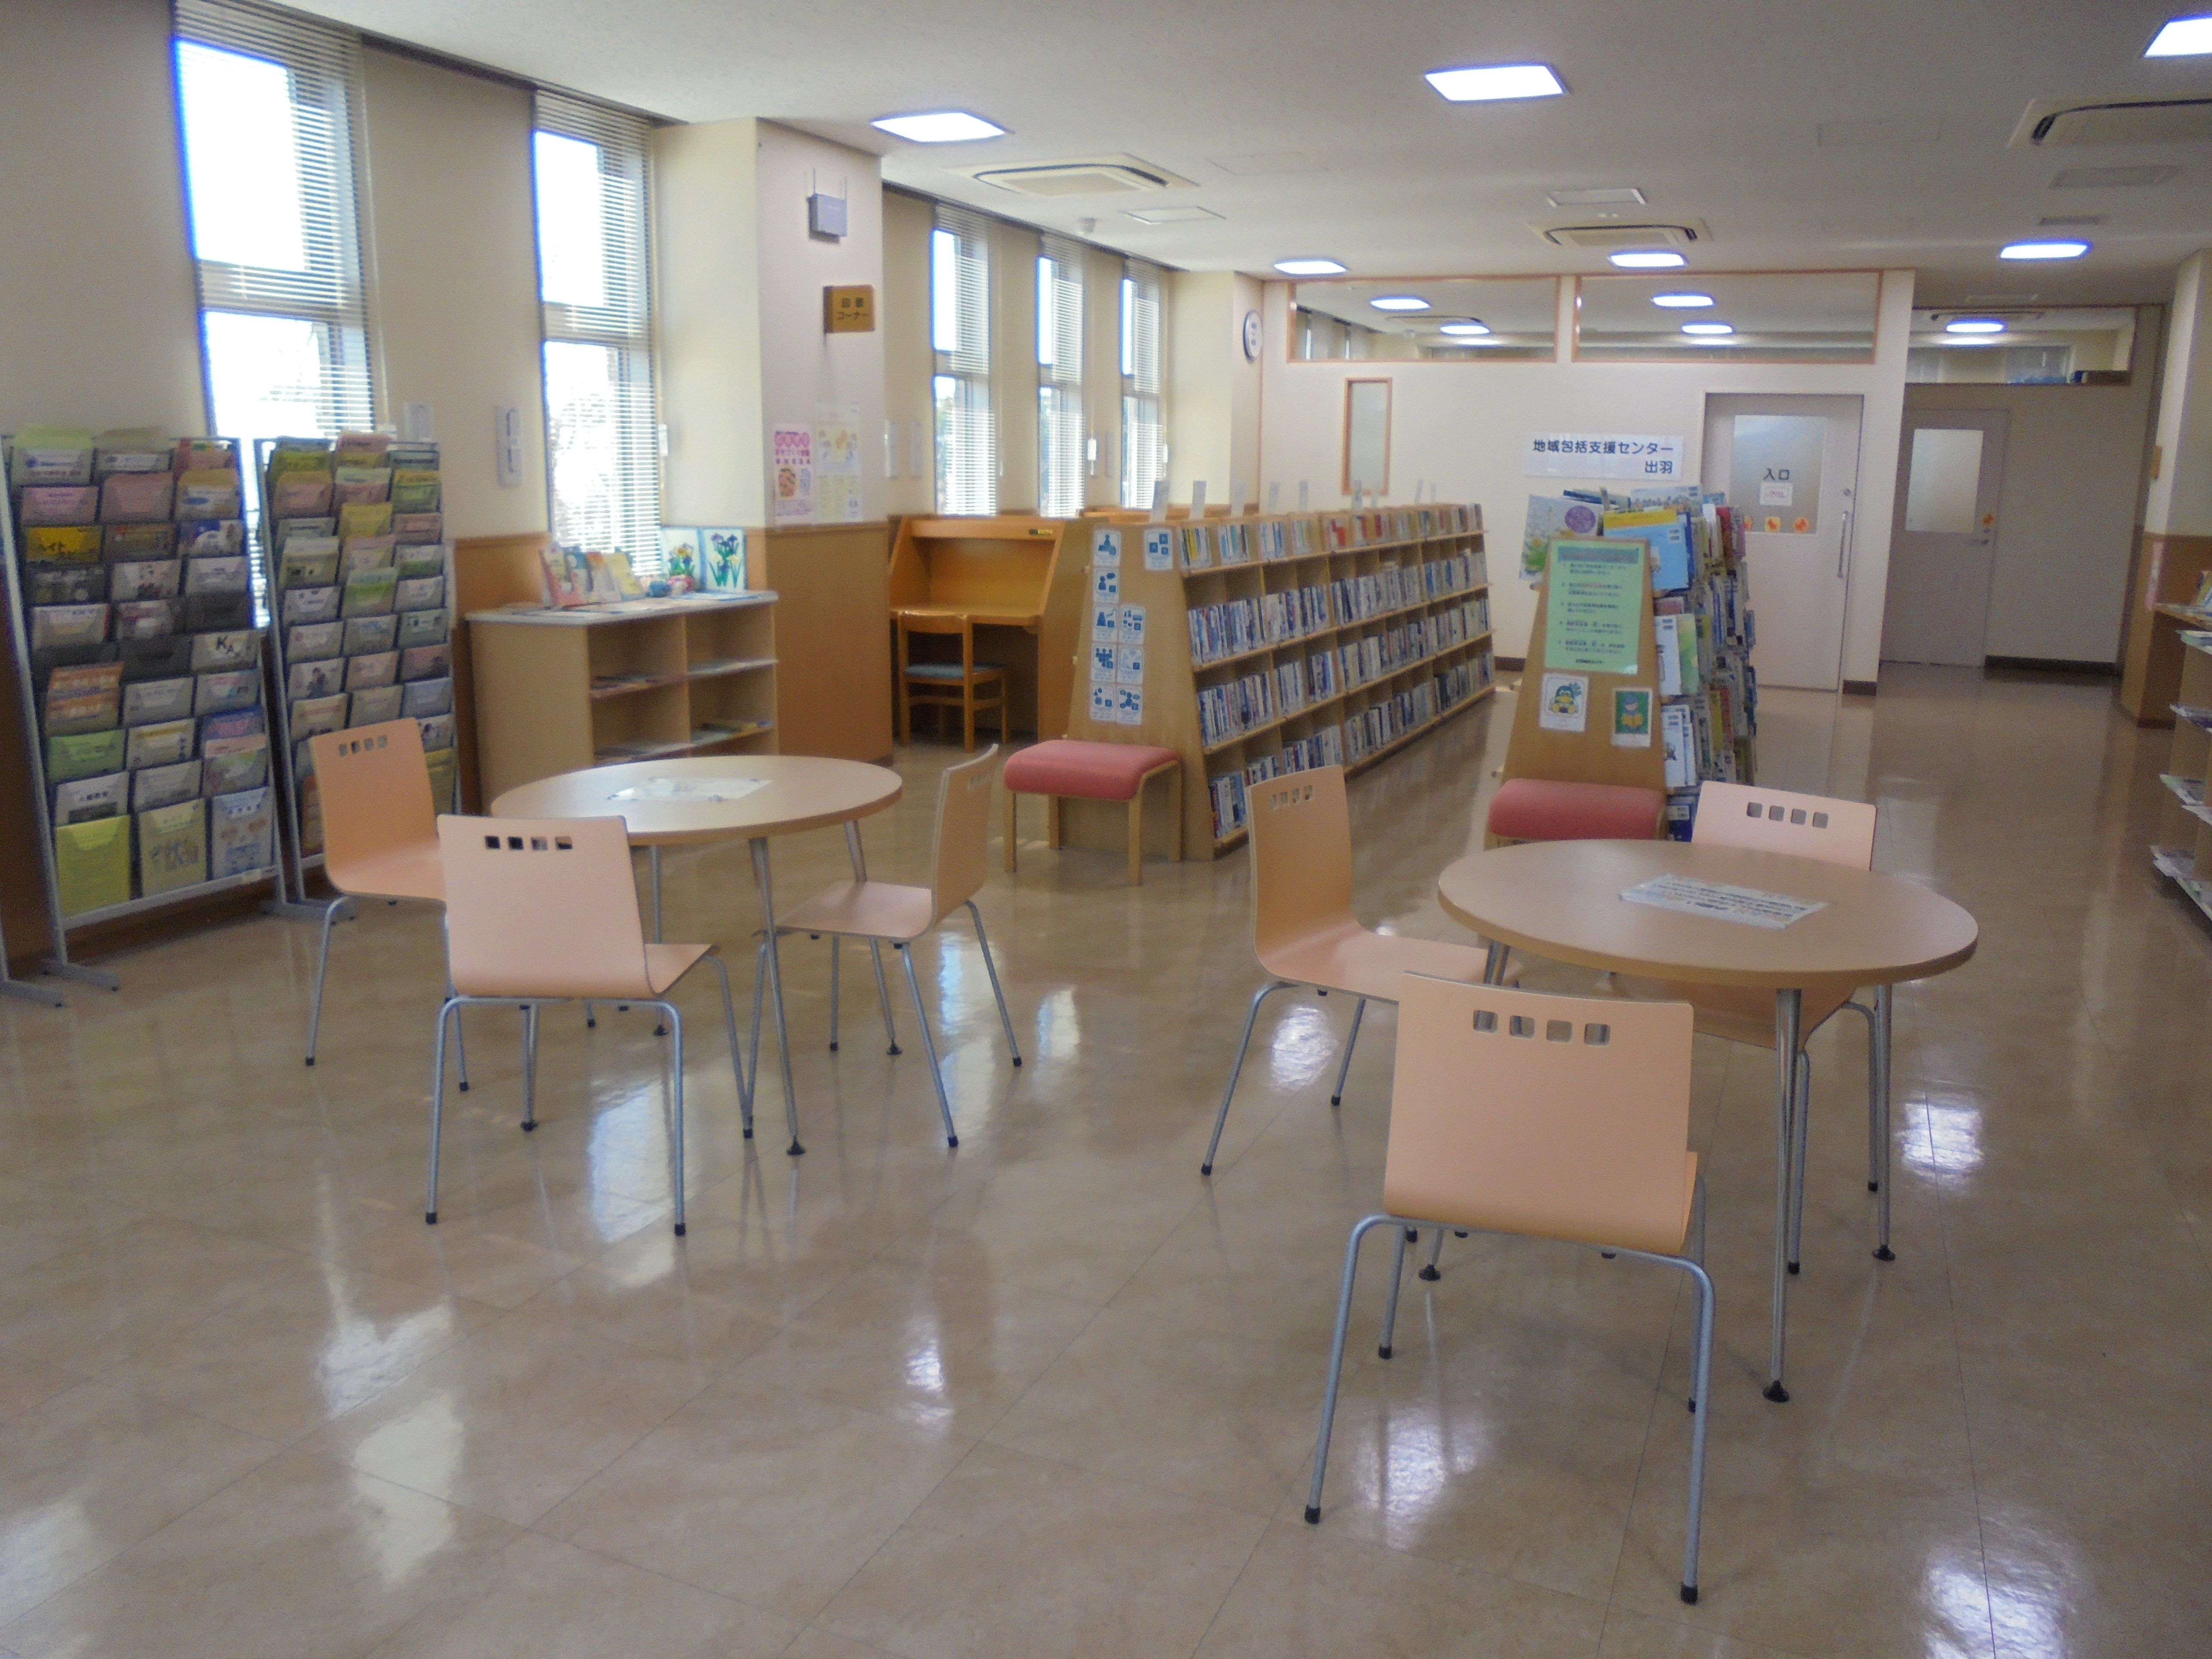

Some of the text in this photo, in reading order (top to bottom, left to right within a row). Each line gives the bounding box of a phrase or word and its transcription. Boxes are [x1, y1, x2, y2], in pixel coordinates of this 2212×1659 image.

[1533, 439, 1674, 454] 地域包括支援センター
[1644, 460, 1673, 474] 出羽
[1763, 468, 1790, 480] 入口
